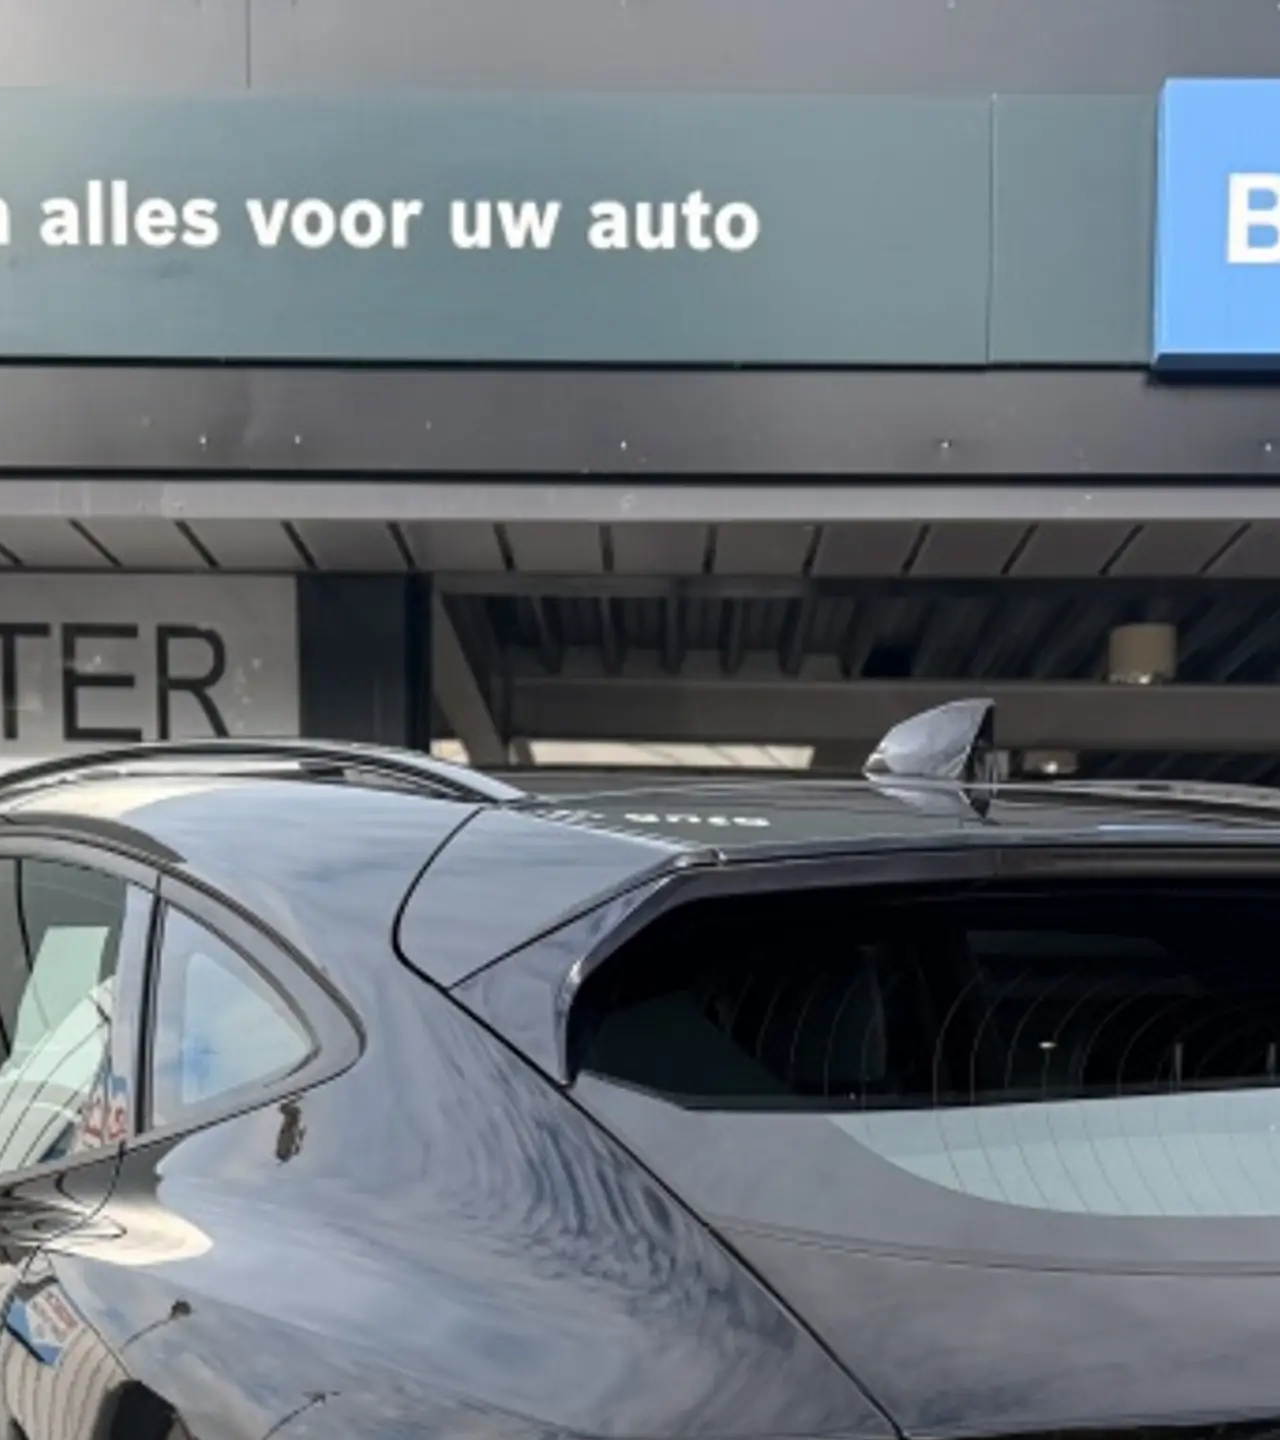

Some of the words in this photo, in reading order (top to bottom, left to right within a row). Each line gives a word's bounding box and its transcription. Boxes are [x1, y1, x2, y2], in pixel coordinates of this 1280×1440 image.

[40, 180, 219, 246] alles
[246, 200, 422, 248] voor
[451, 201, 560, 249] uw
[588, 191, 760, 250] auto
